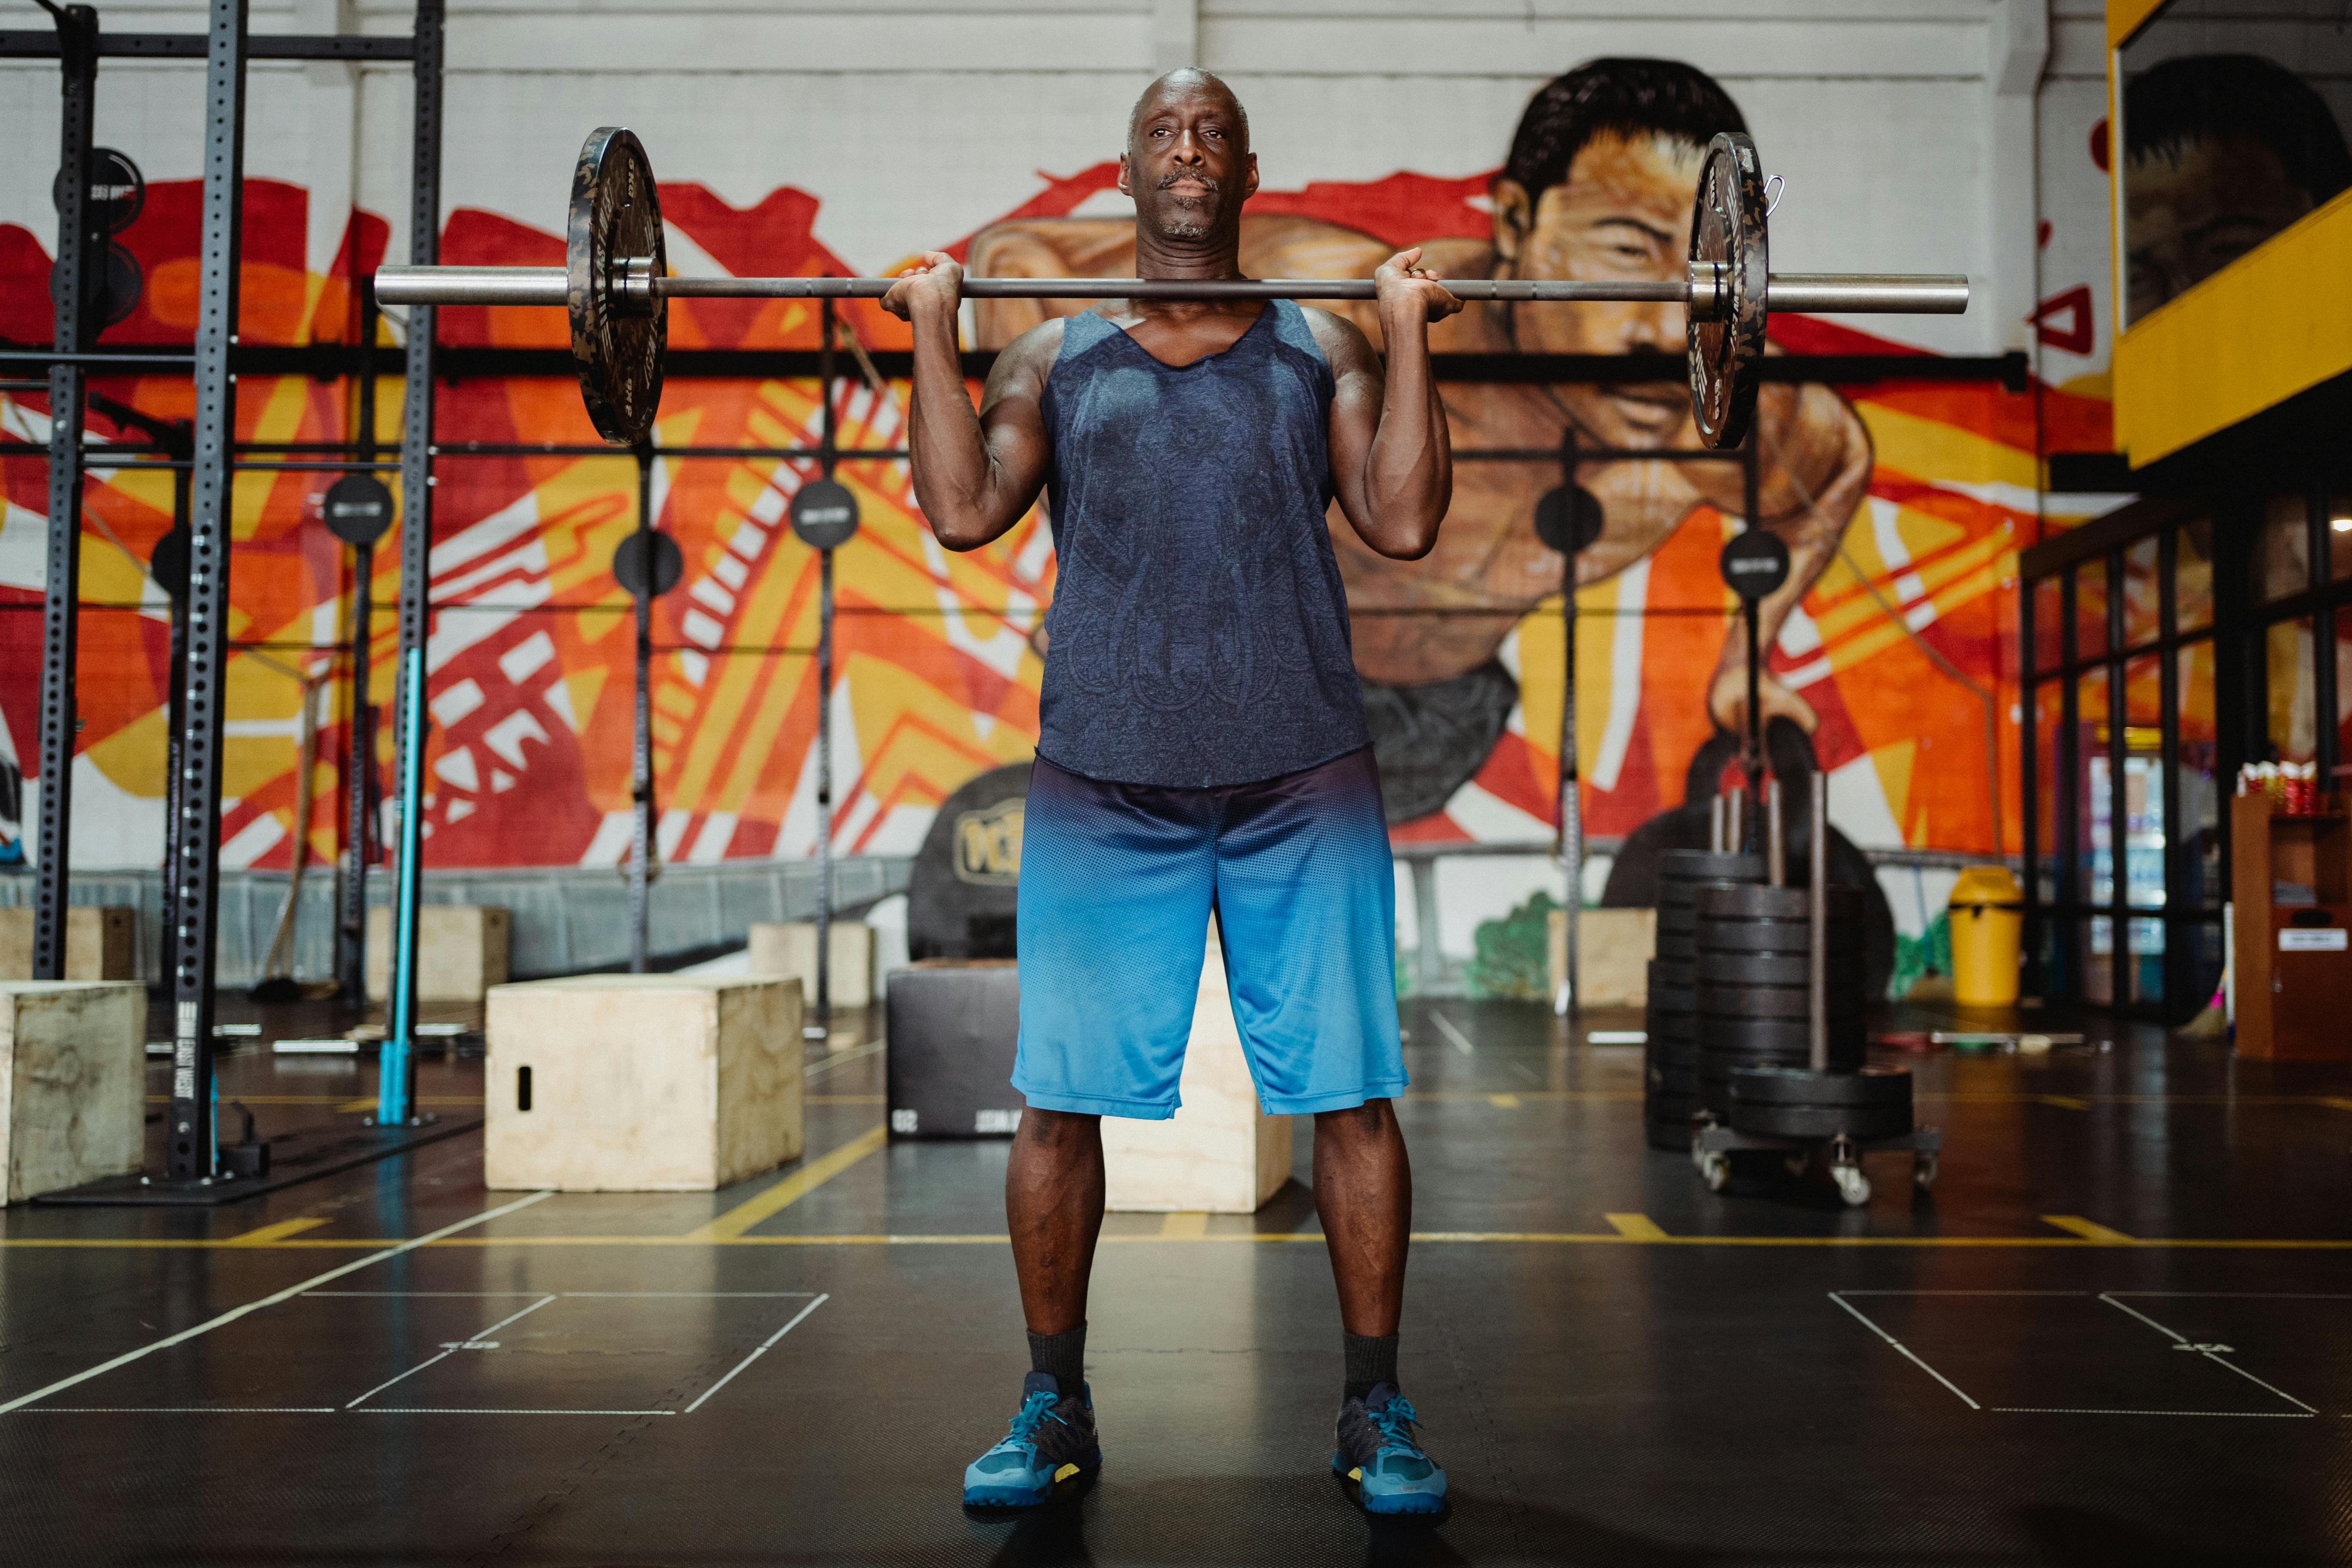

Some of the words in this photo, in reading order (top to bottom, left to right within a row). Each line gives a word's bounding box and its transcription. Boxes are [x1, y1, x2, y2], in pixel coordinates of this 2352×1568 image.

[600, 177, 614, 235] WEST
[1730, 295, 1740, 356] WEST
[175, 1068, 194, 1099] WEST
